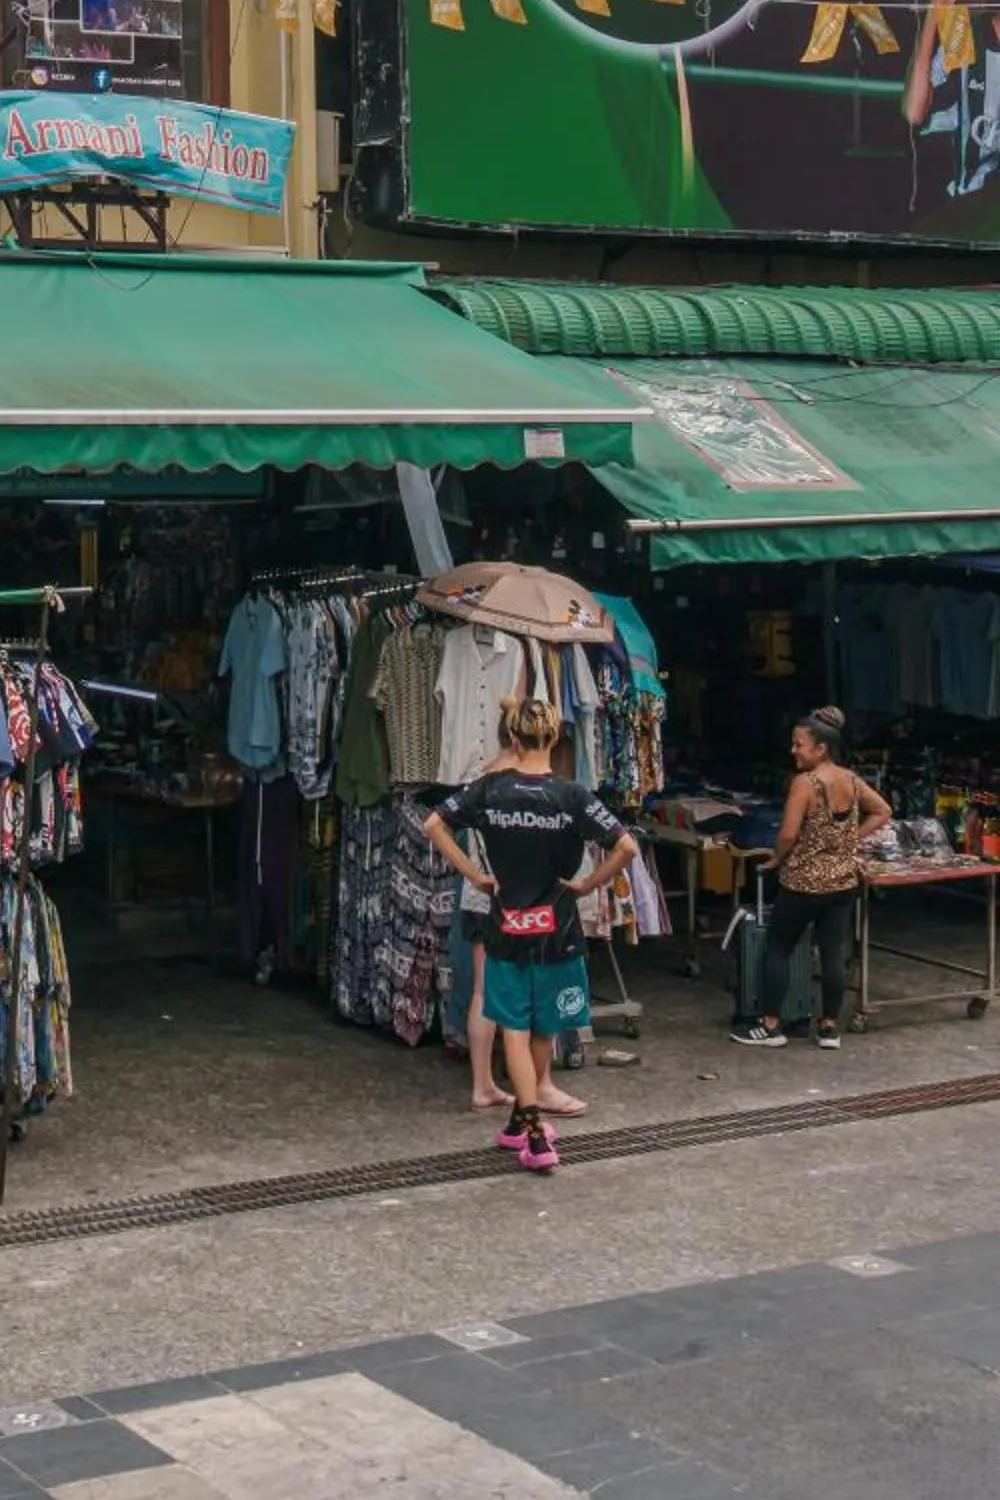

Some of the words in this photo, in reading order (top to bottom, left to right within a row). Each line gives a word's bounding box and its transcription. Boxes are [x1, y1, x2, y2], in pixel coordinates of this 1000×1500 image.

[4, 109, 144, 161] Armani
[155, 115, 270, 183] Fashion
[485, 808, 561, 830] TripADeal
[503, 909, 550, 930] KFC
